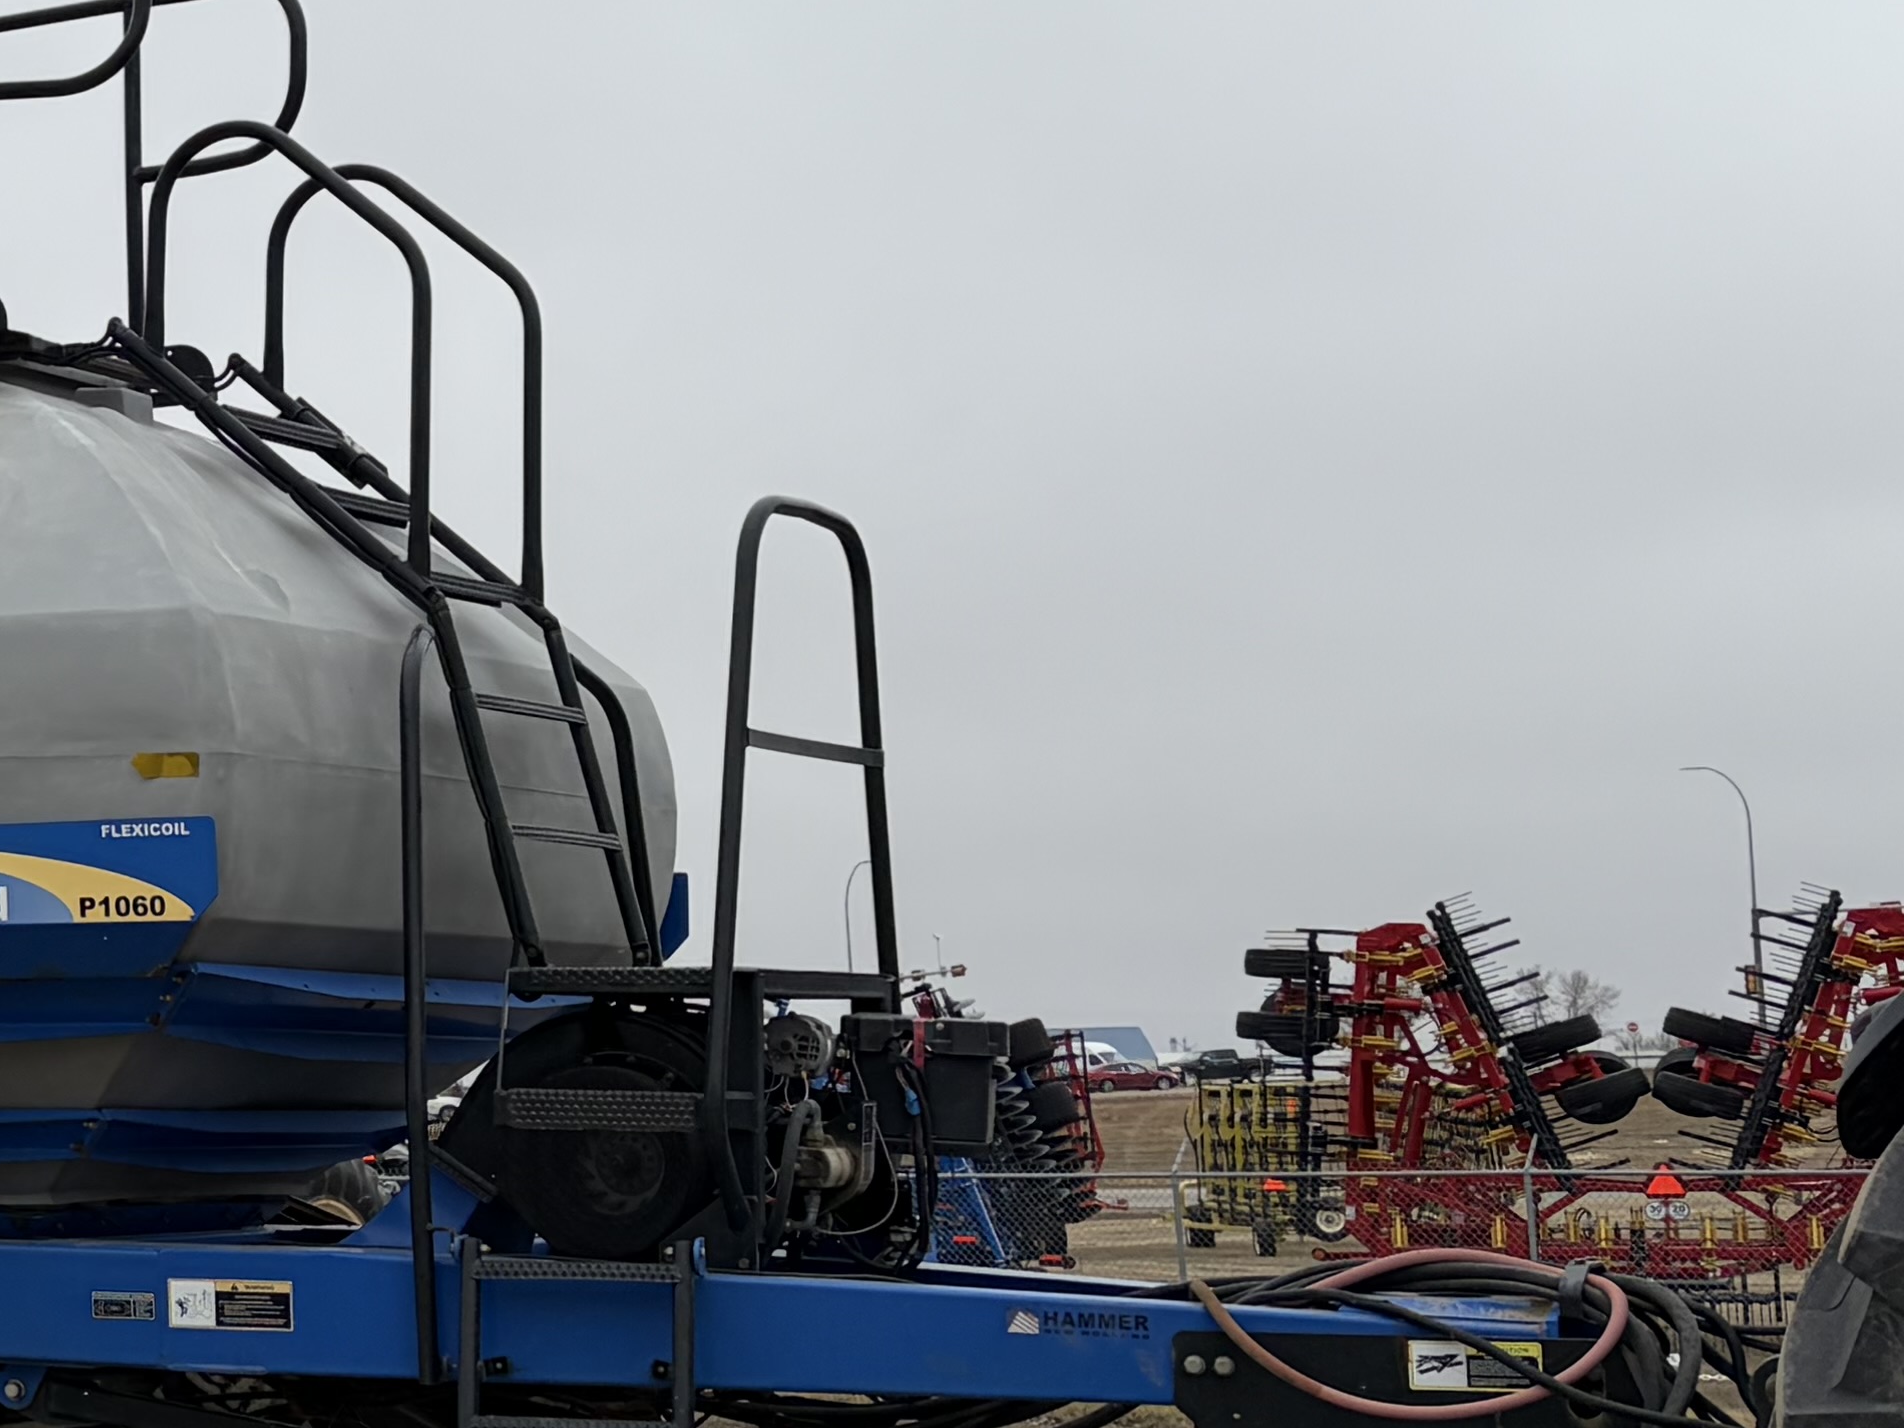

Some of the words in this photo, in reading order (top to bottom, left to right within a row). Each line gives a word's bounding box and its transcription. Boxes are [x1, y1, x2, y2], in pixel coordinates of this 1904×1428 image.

[100, 821, 191, 839] FLEXICOIL
[78, 895, 166, 918] P1060
[1042, 1310, 1150, 1332] HAMMER
